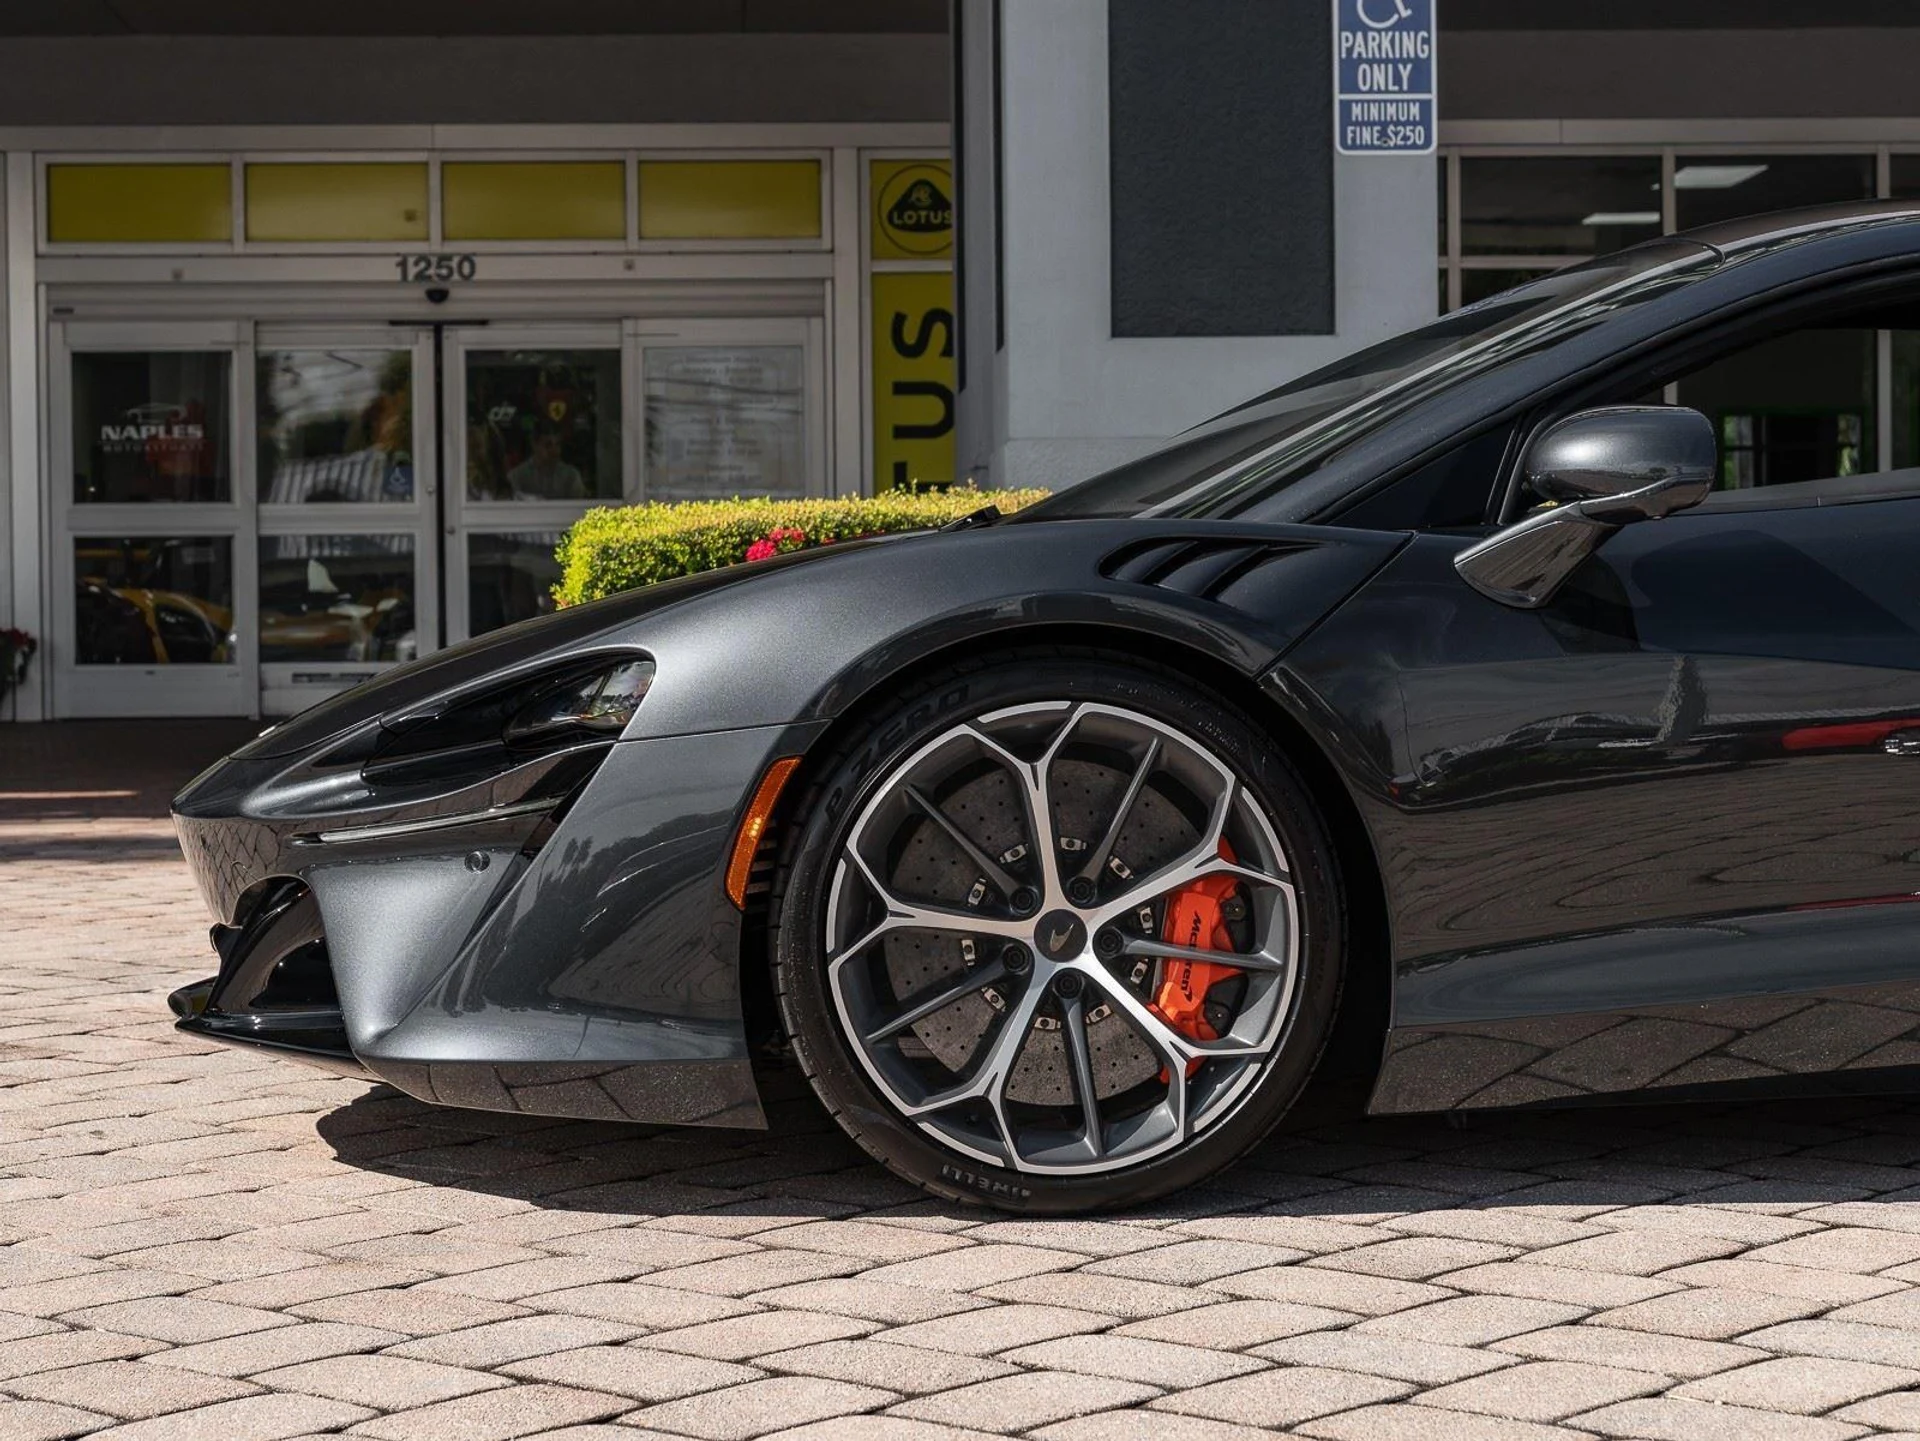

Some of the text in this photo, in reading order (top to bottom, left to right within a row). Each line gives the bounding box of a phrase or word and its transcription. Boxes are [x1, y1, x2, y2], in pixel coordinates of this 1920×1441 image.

[1341, 31, 1429, 59] PARKING
[1357, 63, 1413, 92] ONLY
[1351, 102, 1420, 122] MINIMUM
[1347, 124, 1425, 147] FINE $250
[892, 210, 953, 225] LOTUS
[395, 253, 476, 281] 1250
[101, 425, 204, 440] NAPLES
[824, 684, 969, 824] P ZERO
[1181, 910, 1202, 993] McLren
